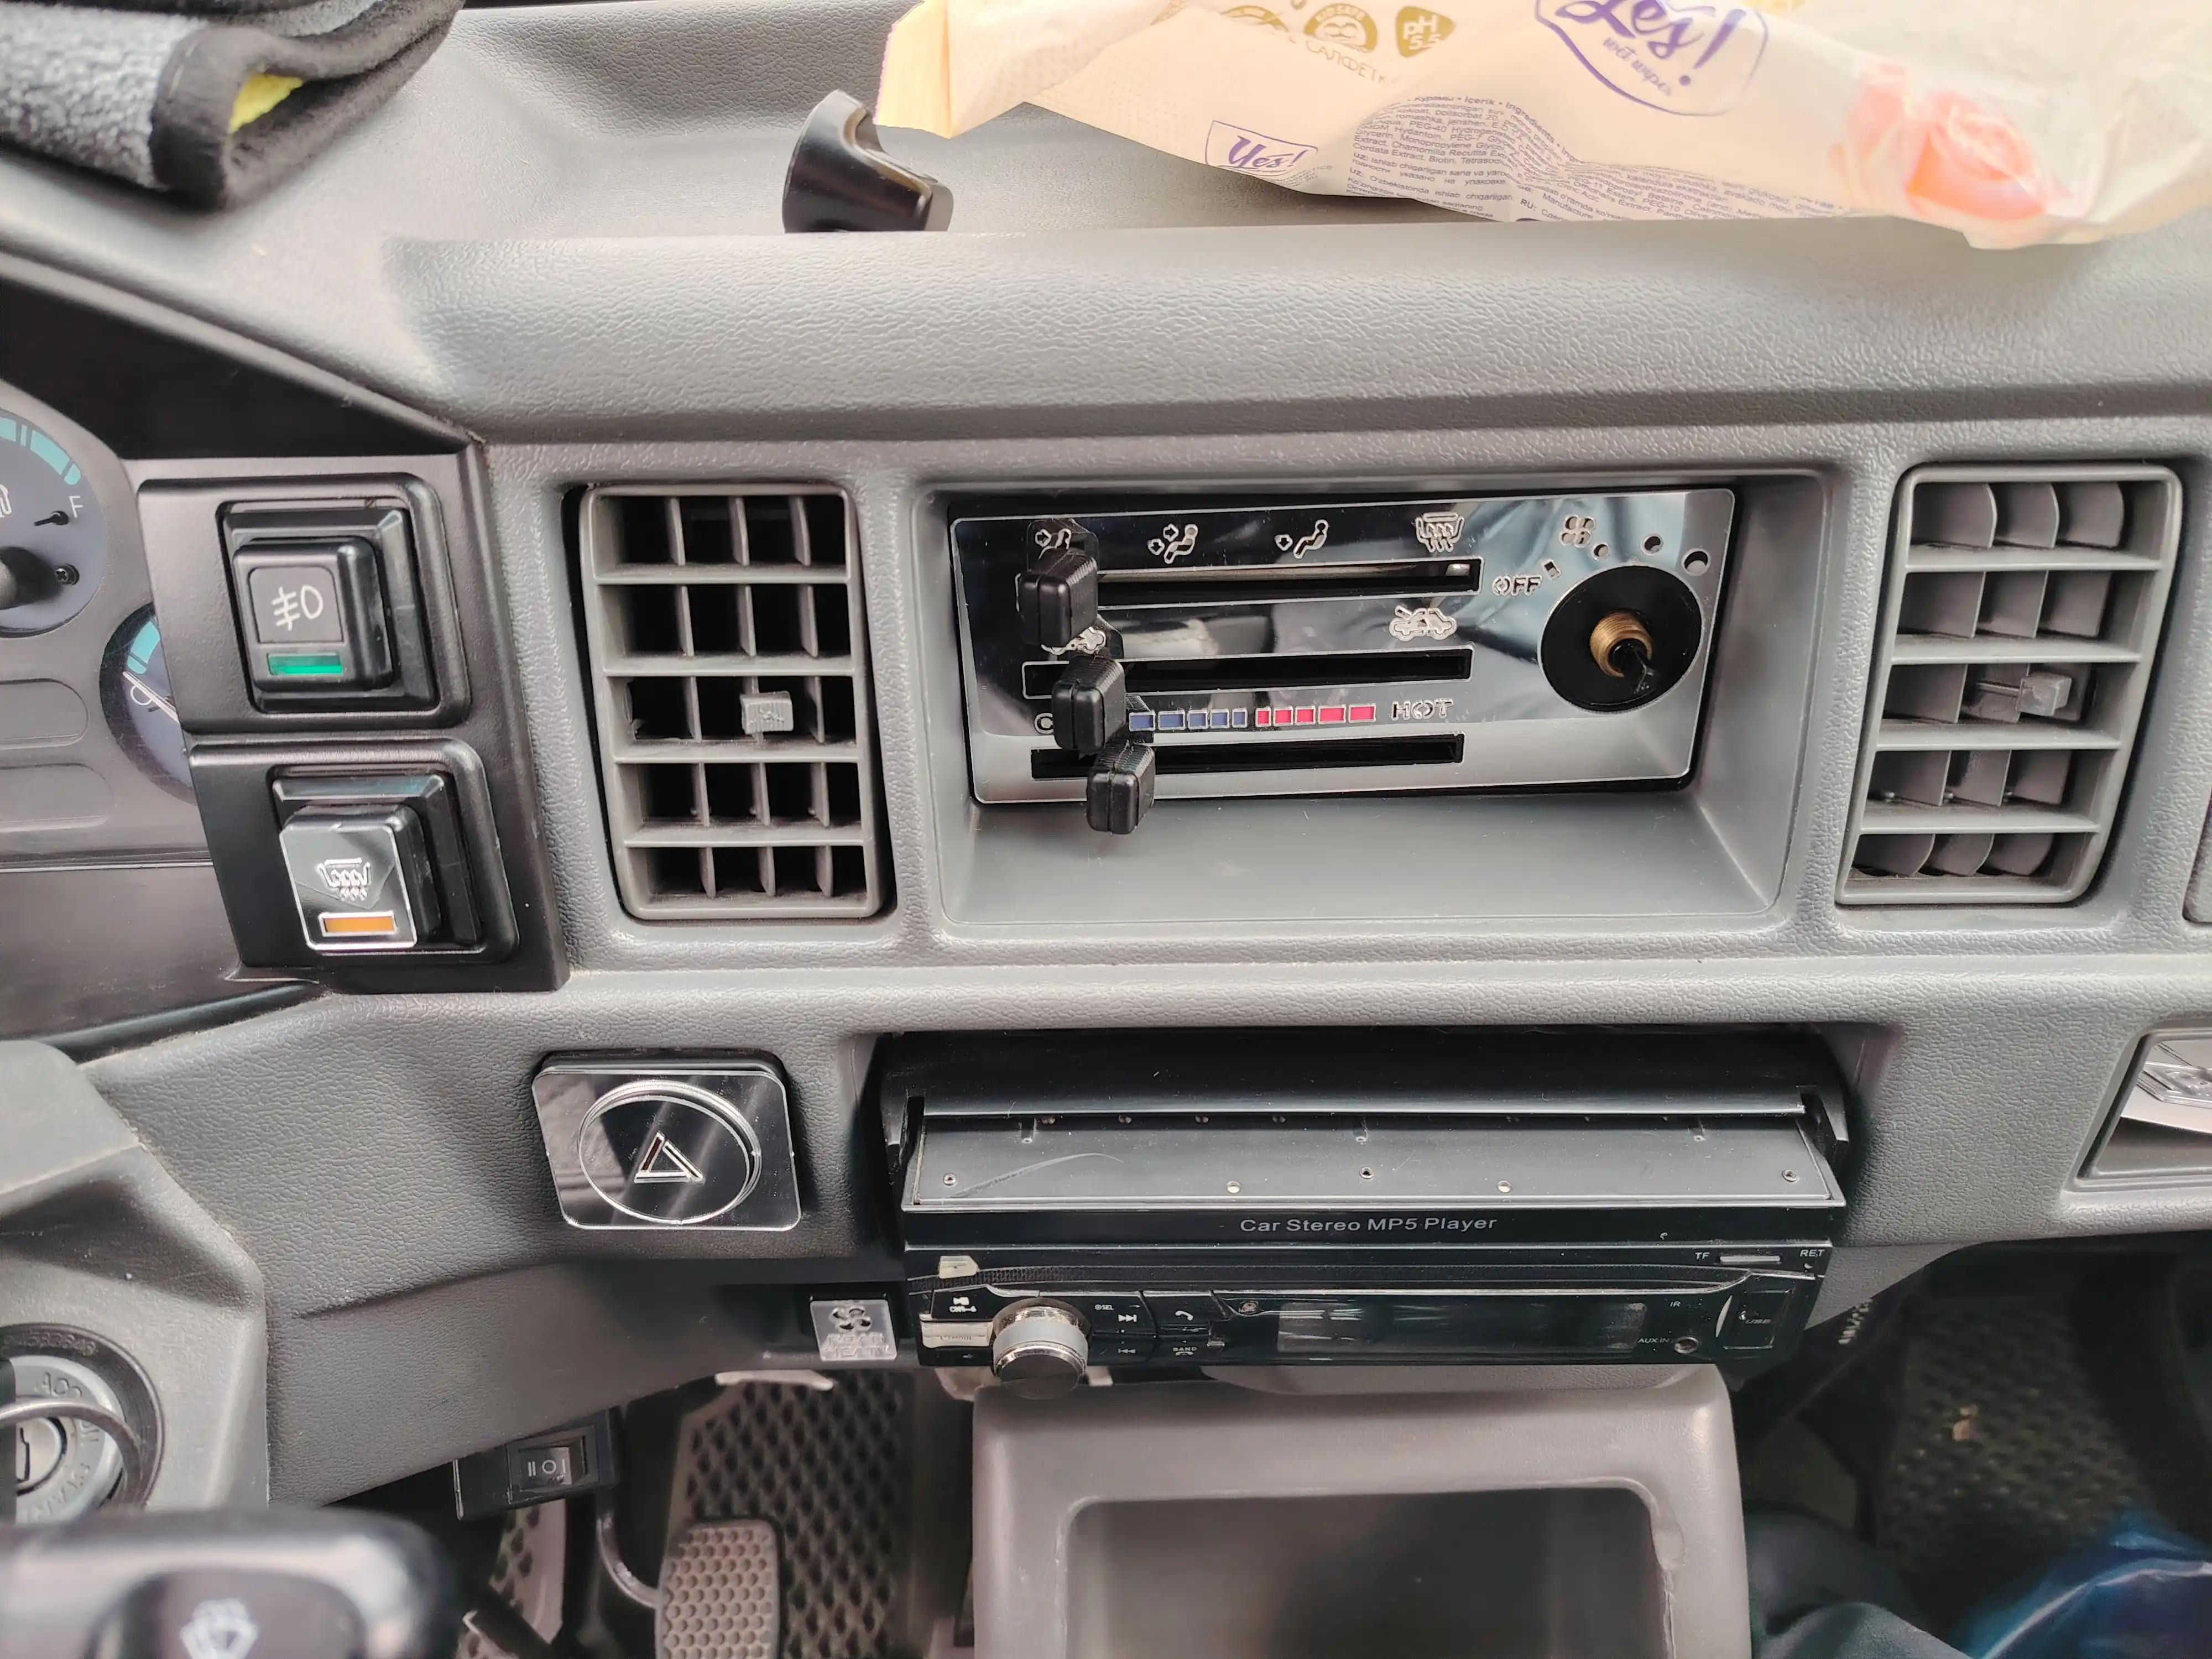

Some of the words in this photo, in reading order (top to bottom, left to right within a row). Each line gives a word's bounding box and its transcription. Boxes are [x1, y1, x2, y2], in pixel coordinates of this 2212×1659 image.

[1404, 14, 1436, 40] pH
[1228, 135, 1308, 169] Yes!
[1353, 143, 1389, 155] Cordata
[1520, 198, 1537, 211] RU:
[69, 495, 84, 518] F
[1493, 575, 1542, 596] OFF
[1391, 698, 1454, 721] HOT
[1240, 1218, 1280, 1232] Car
[1286, 1218, 1360, 1232] Stereo
[1368, 1218, 1417, 1231] MP5
[1424, 1218, 1497, 1232] Player
